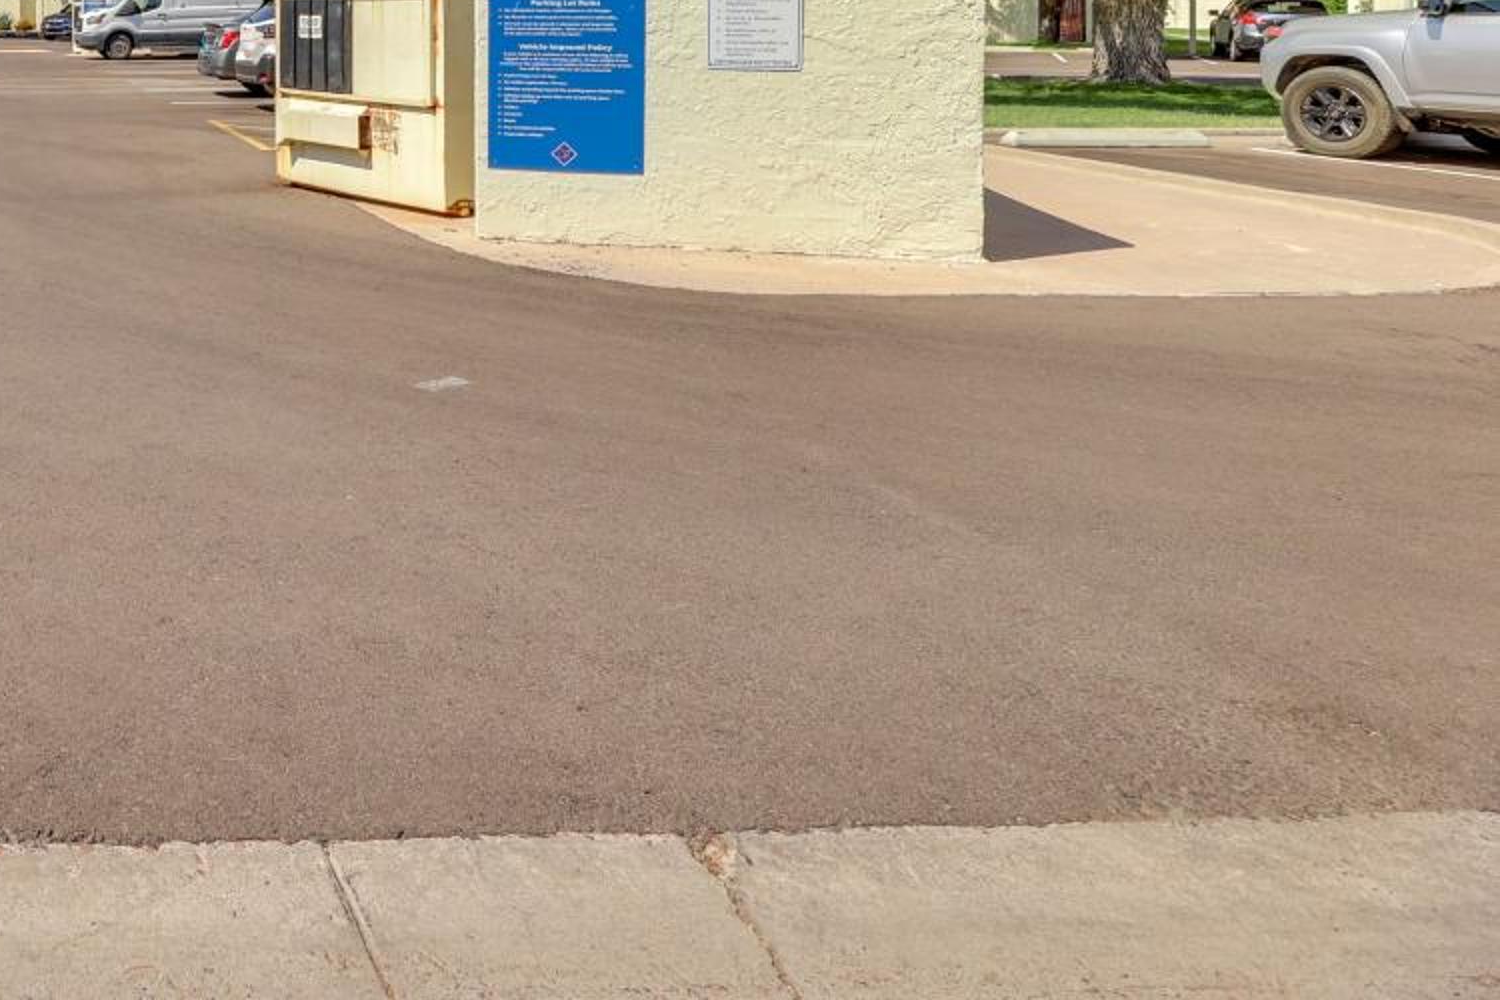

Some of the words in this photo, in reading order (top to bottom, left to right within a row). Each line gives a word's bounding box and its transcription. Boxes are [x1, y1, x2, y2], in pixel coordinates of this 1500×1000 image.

[530, 0, 562, 8] Parking
[518, 43, 548, 51] Vehicle
[549, 43, 586, 52] Impound
[587, 43, 613, 53] Policy
